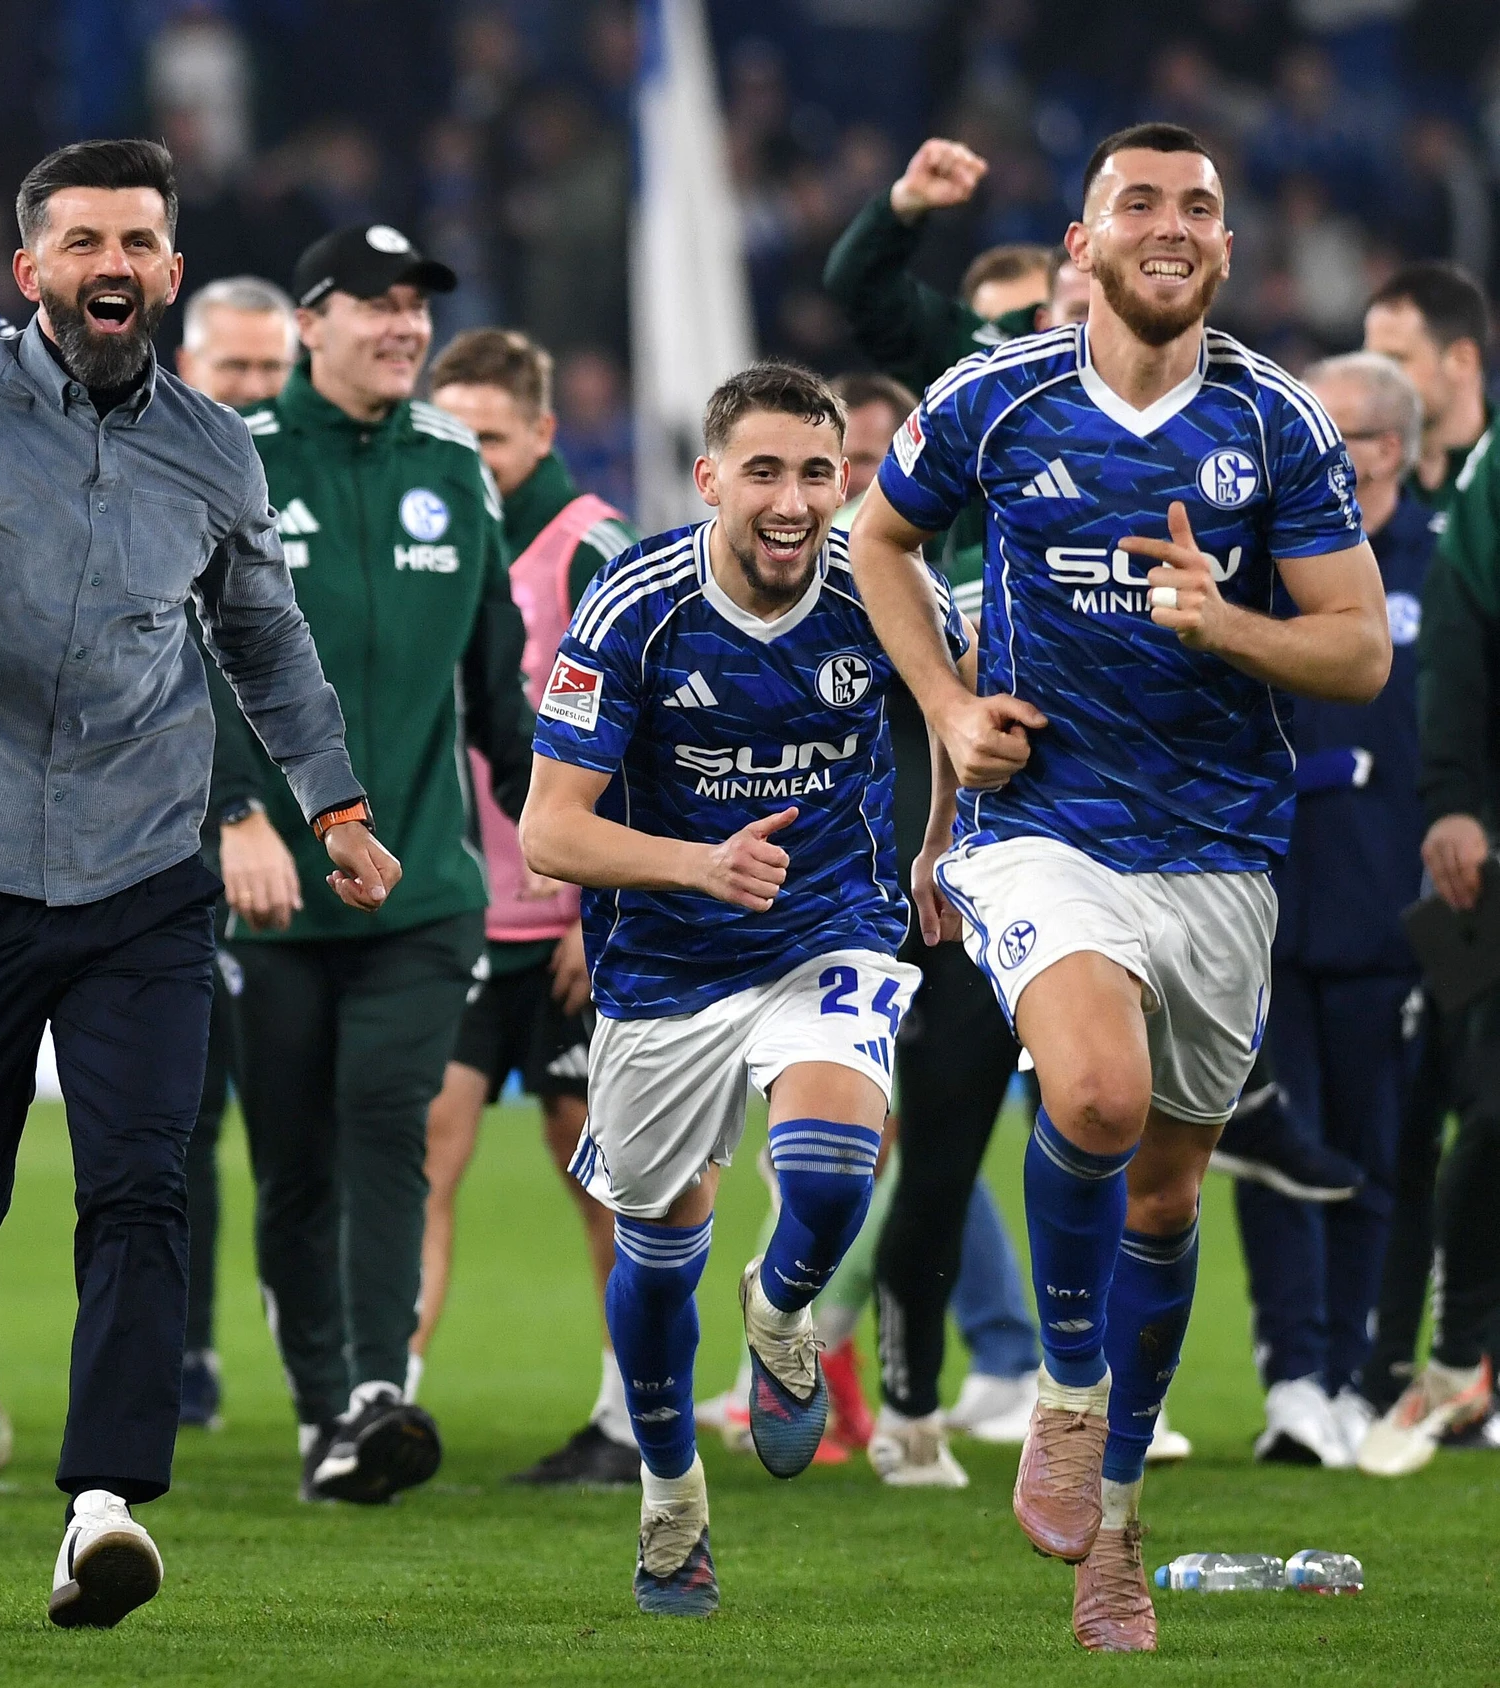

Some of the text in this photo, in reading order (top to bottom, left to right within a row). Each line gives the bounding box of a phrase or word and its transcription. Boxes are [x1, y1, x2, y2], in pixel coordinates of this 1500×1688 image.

[394, 544, 459, 573] HRS
[544, 703, 591, 725] BUNDESLIGA
[674, 733, 859, 776] SUN
[695, 768, 836, 801] MINIMEAL
[819, 966, 901, 1040] 24
